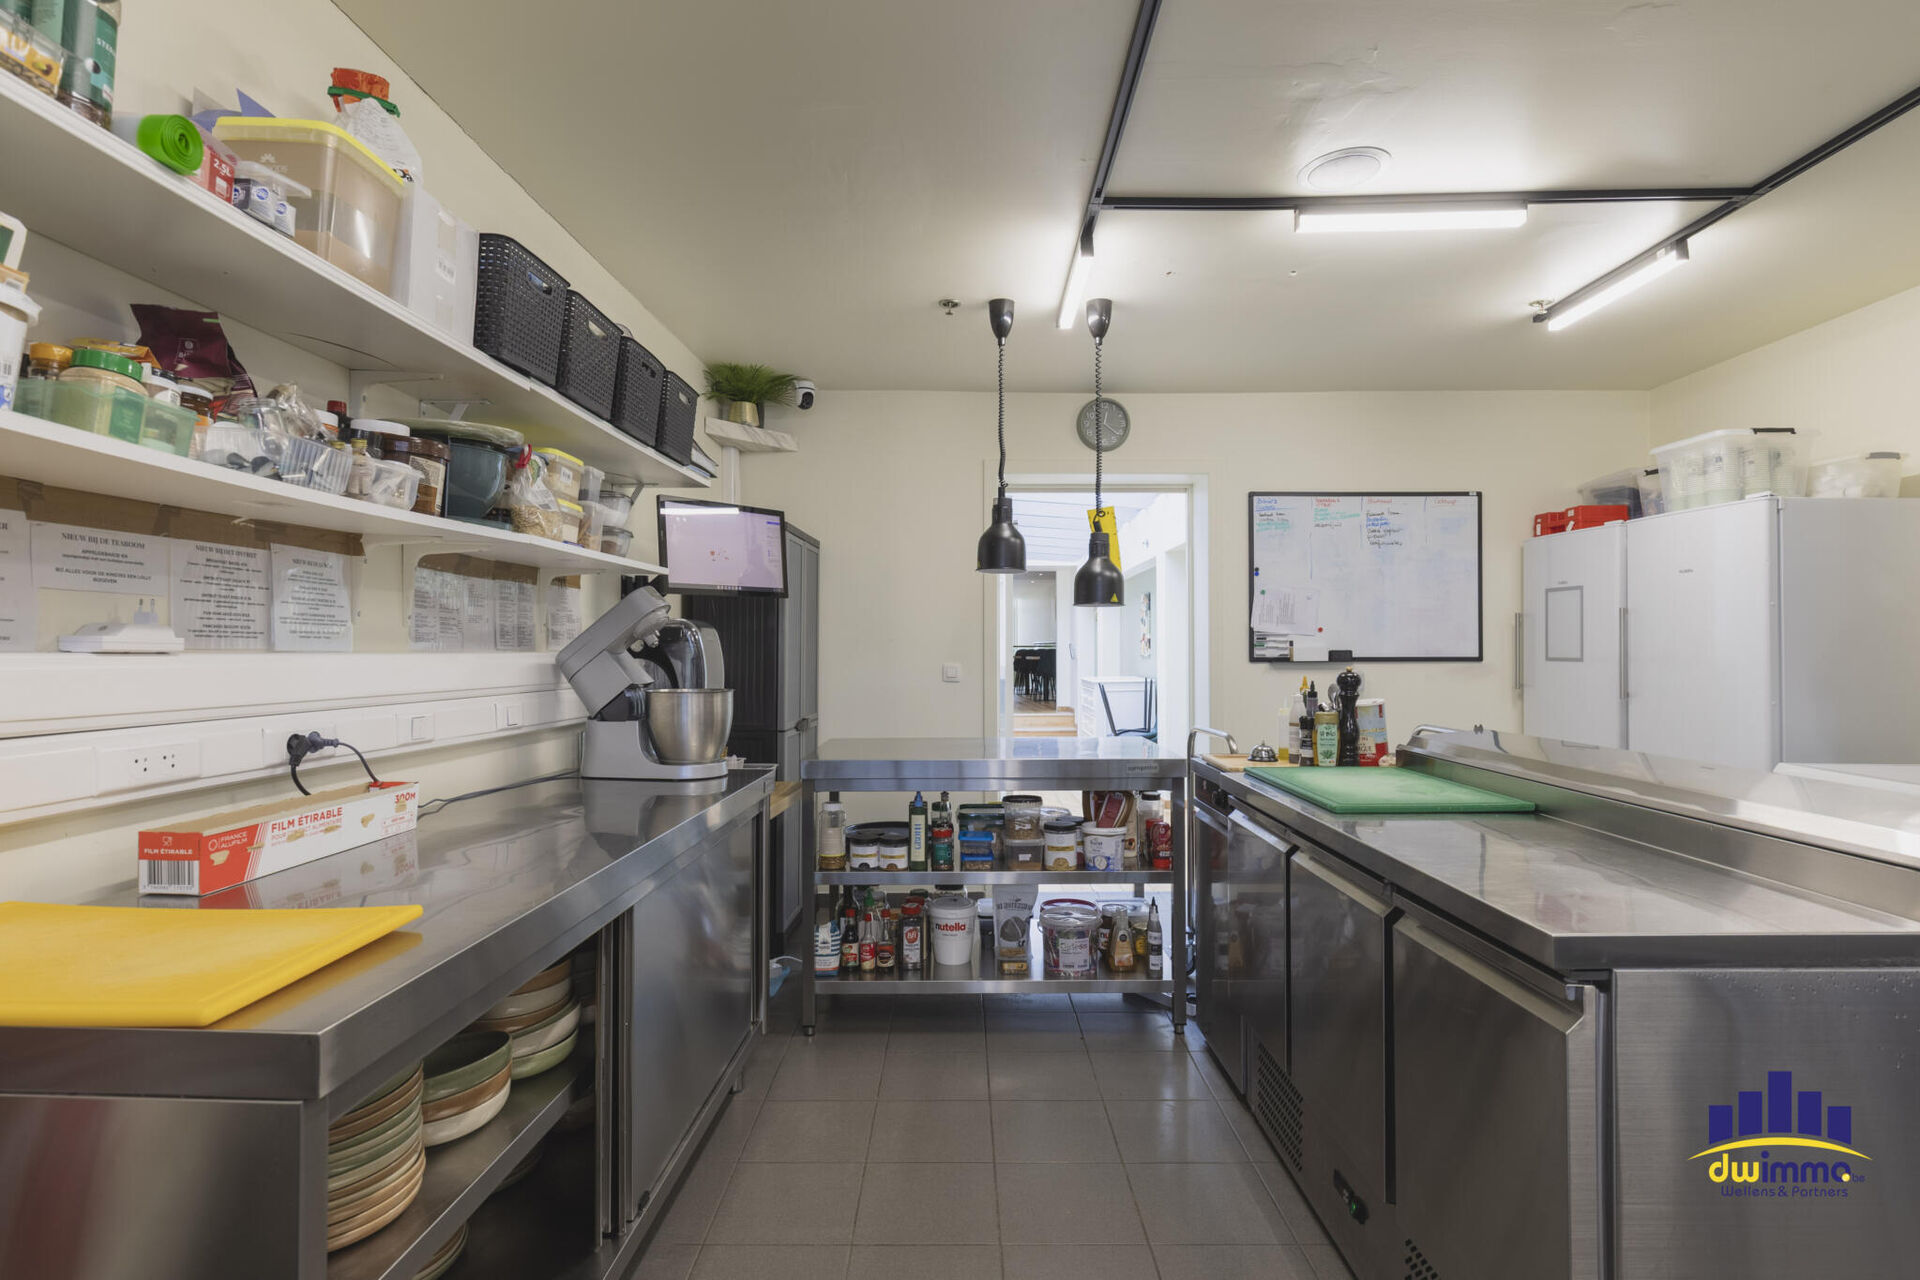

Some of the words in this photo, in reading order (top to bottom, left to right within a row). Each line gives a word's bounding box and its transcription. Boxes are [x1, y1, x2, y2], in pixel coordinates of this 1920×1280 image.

[213, 158, 232, 177] 2.5L
[61, 532, 87, 542] NIEUW
[271, 818, 295, 833] FILM
[221, 831, 248, 842] FRANCE
[935, 922, 966, 932] nutella
